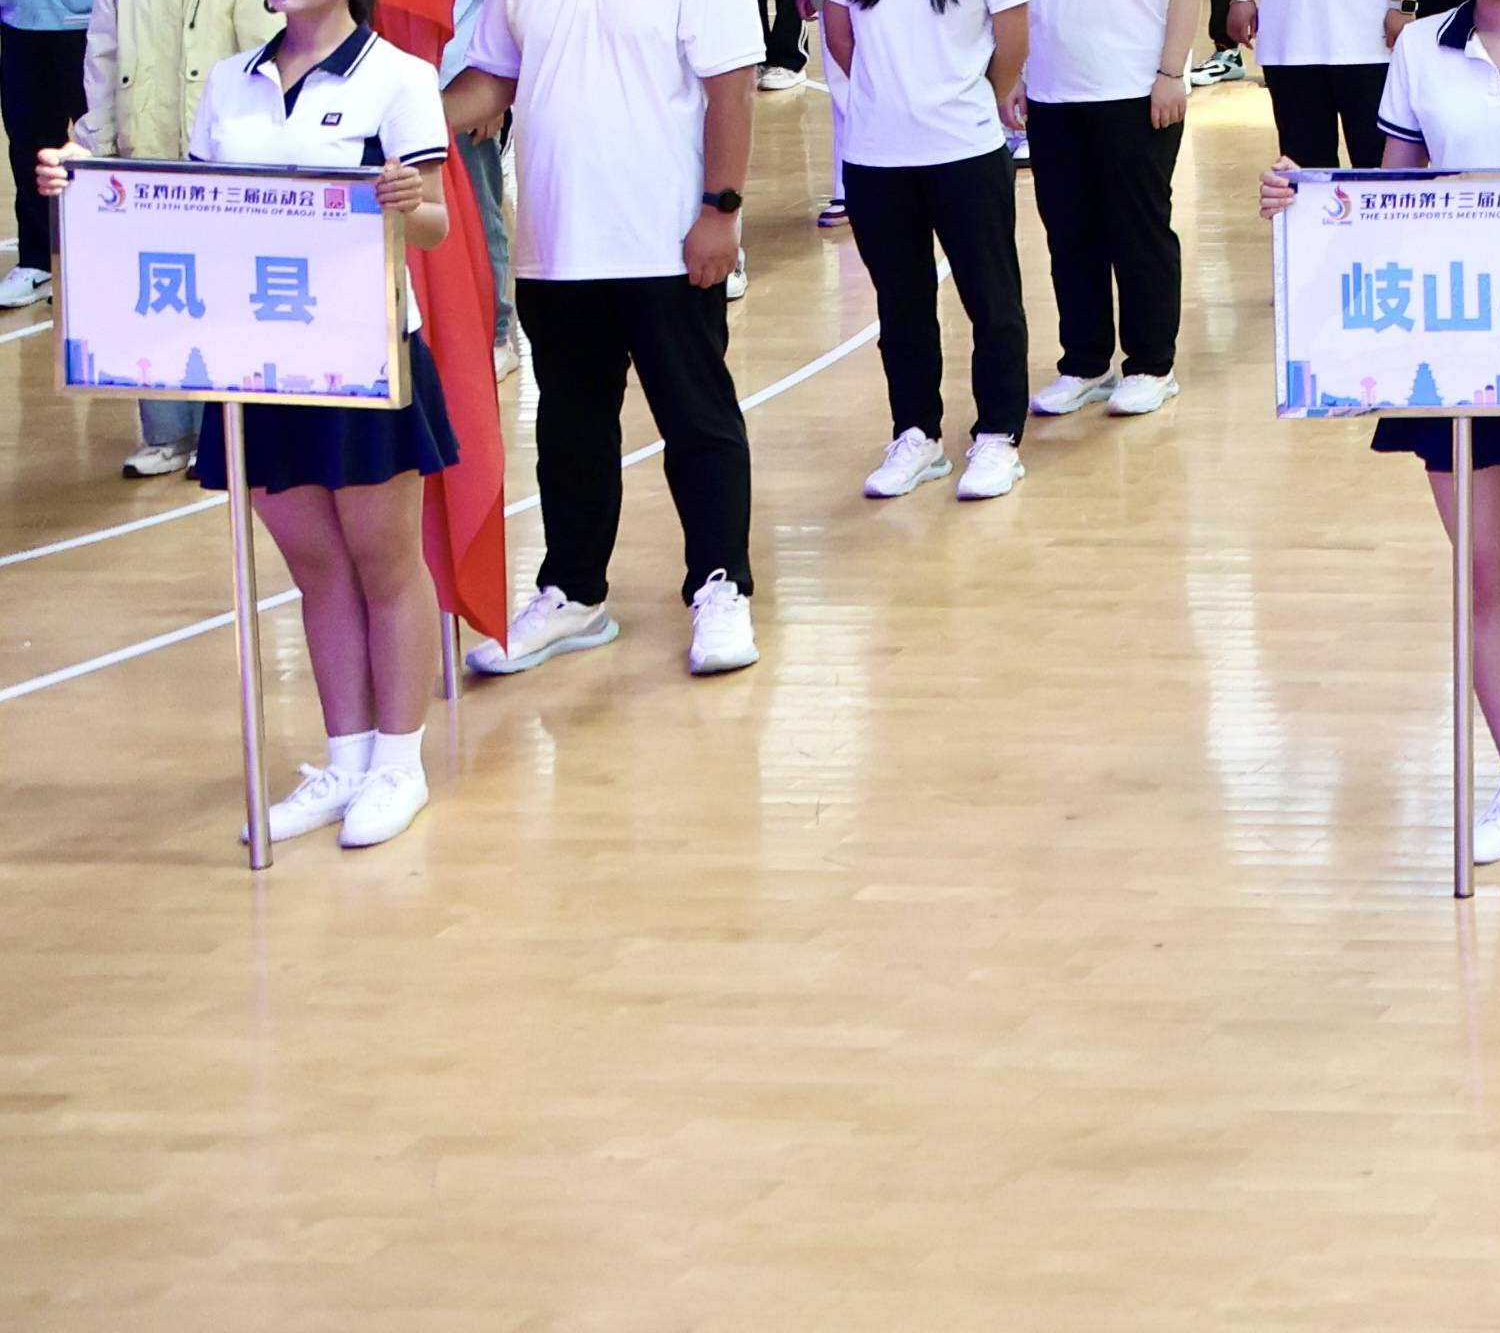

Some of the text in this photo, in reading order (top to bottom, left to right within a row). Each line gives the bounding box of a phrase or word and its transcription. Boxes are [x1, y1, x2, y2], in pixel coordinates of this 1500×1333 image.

[133, 182, 315, 207] 宝鸡市第十三届运动会
[134, 201, 151, 210] THE
[156, 203, 181, 211] 13TH
[184, 204, 222, 213] SPORTS
[224, 206, 269, 215] MEETING
[271, 208, 283, 216] OF
[1413, 212, 1453, 220] SPORTS
[133, 250, 319, 325] 凤县
